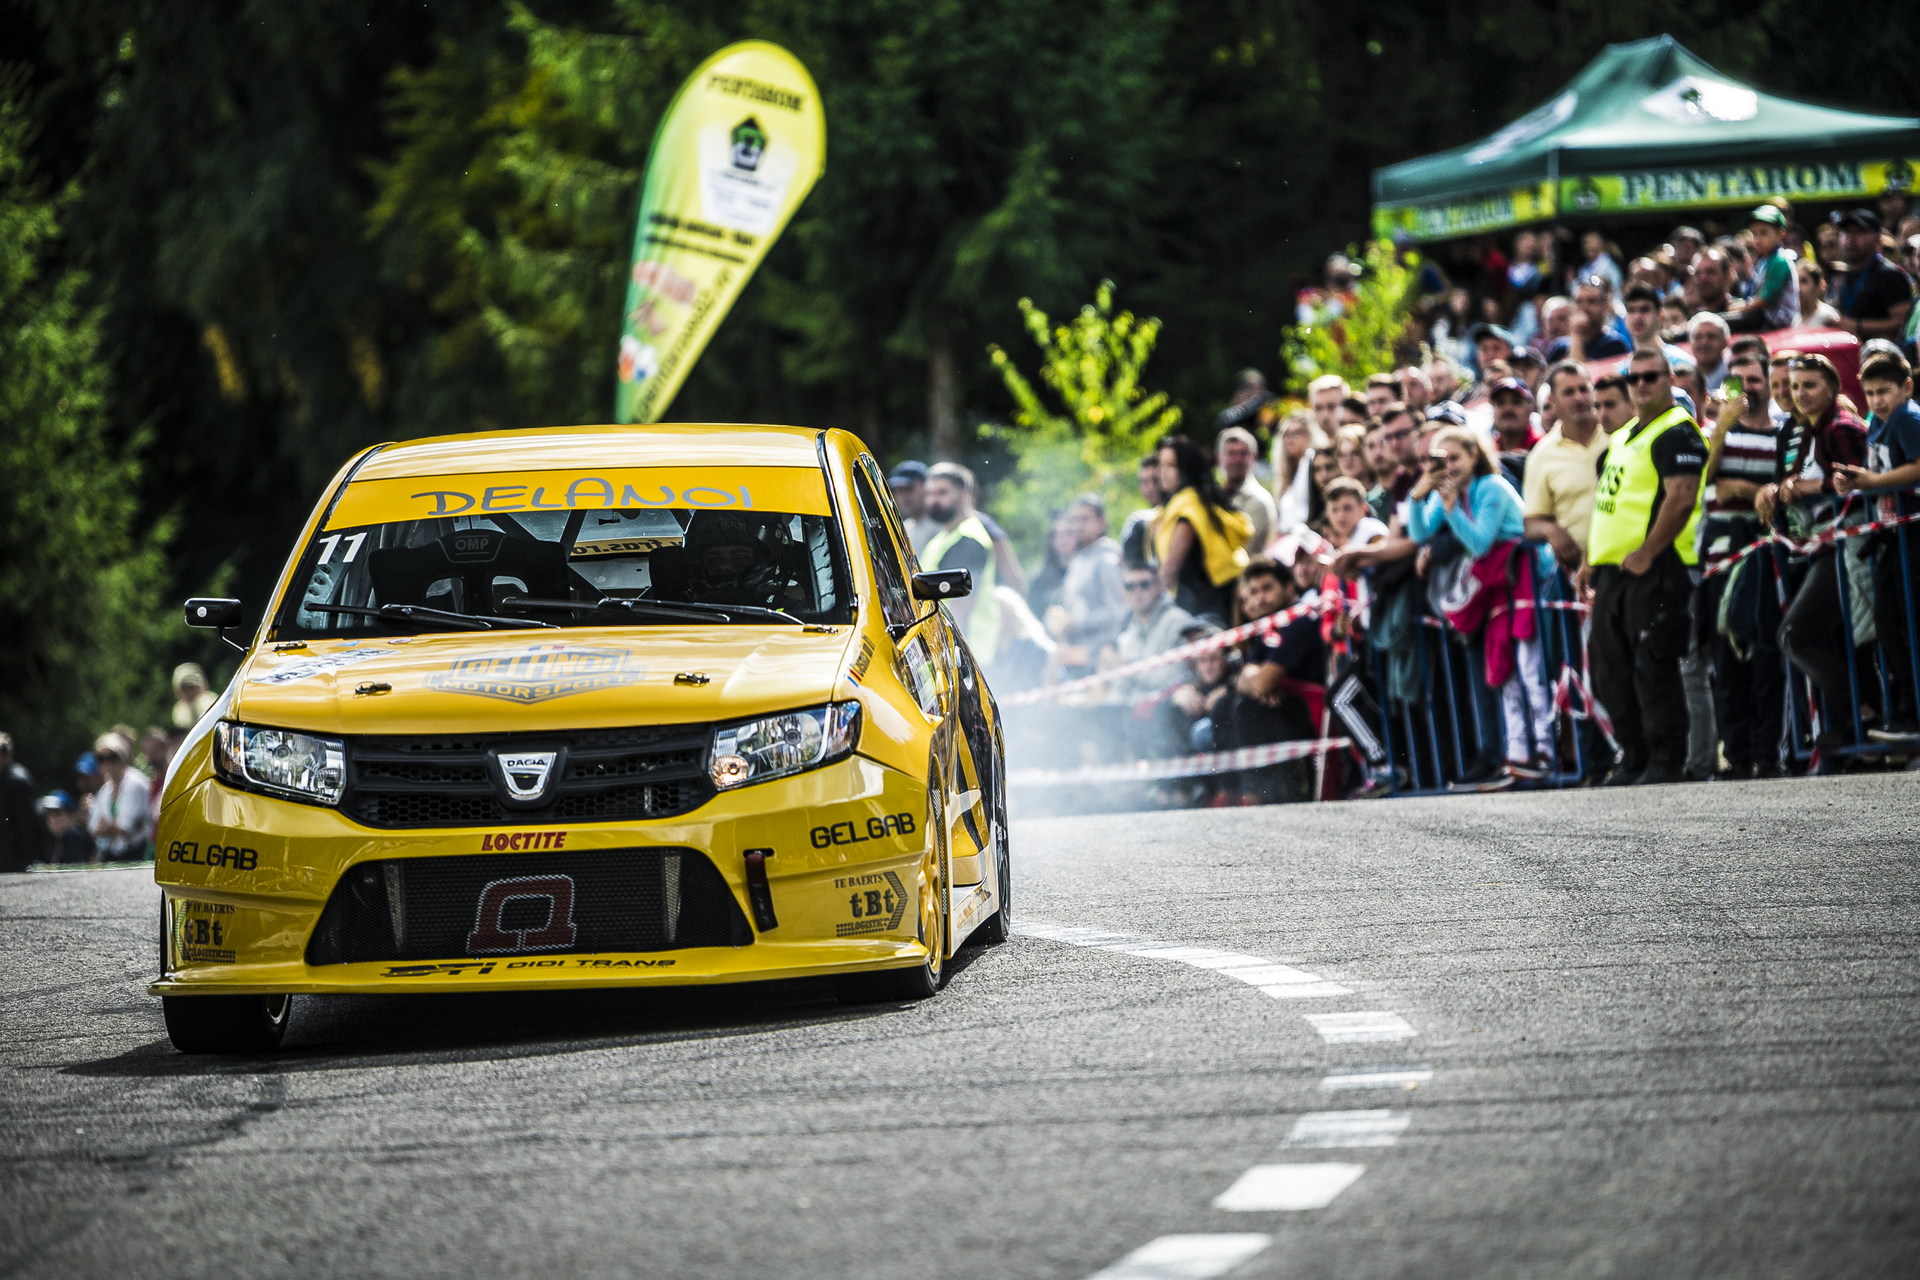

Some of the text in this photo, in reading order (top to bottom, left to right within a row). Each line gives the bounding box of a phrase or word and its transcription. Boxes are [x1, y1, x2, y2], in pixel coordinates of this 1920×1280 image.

[1620, 163, 1867, 205] PENTAROM
[411, 477, 753, 516] DELANOI
[317, 532, 368, 565] 11
[455, 538, 489, 551] OMP
[507, 759, 545, 767] DACIA
[481, 831, 567, 851] LOCTITE
[810, 812, 916, 849] GELGAB
[168, 841, 258, 871] GELGAB
[848, 873, 884, 888] BAERTS
[849, 887, 895, 919] tBt
[184, 918, 223, 947] tBt
[506, 960, 565, 969] DIDI
[576, 959, 677, 967] TRANS
